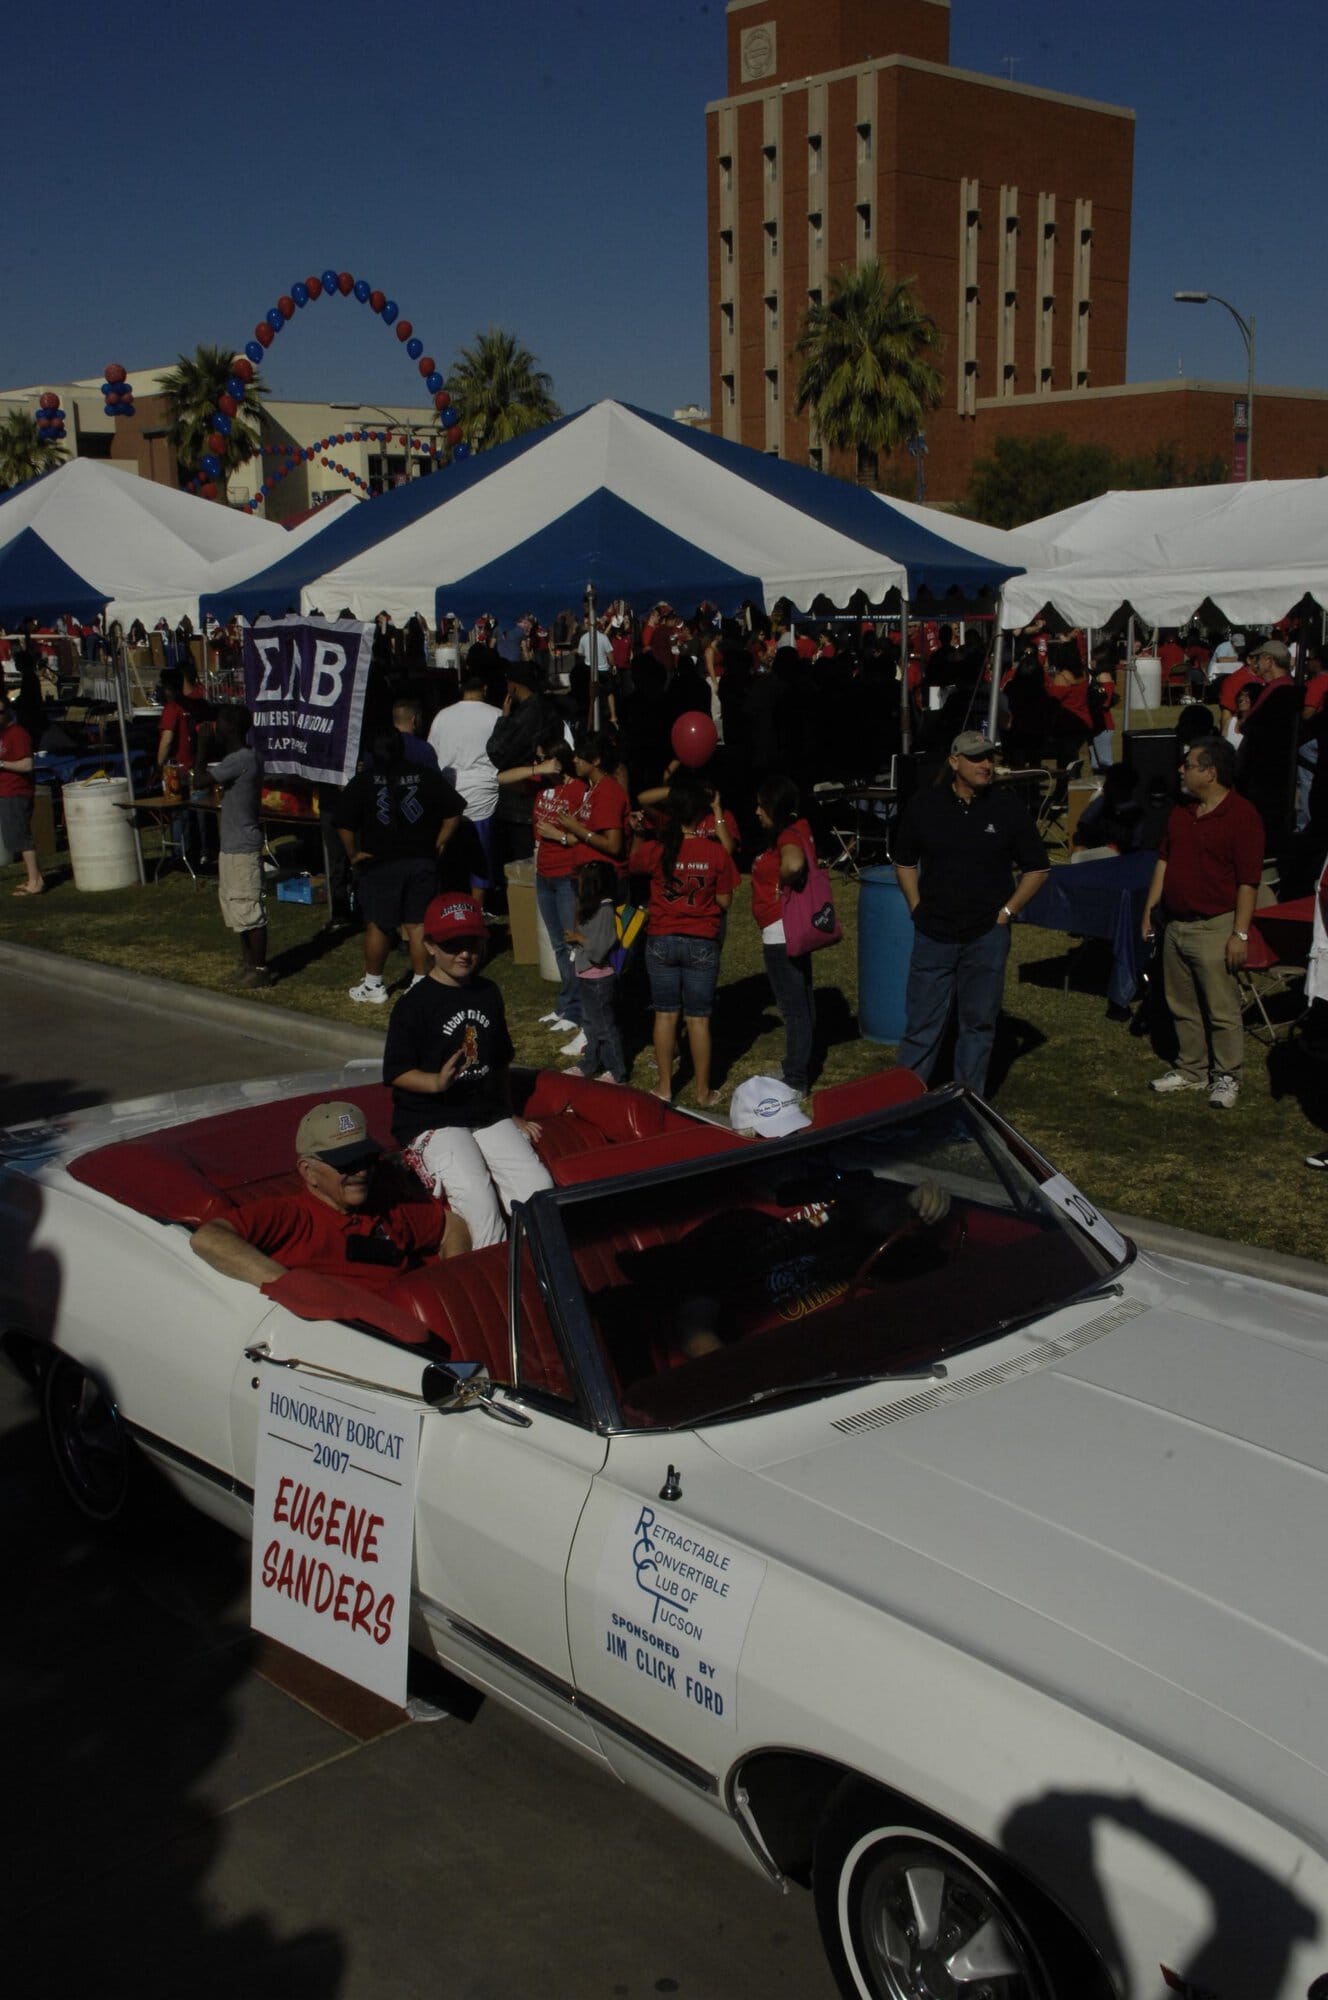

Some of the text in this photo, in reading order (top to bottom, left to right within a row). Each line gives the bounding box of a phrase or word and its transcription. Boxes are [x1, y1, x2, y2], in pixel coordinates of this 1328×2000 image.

[270, 1391, 404, 1460] HONORARY BOBCAT
[313, 1442, 350, 1474] 2007
[273, 1476, 385, 1563] EUGENE
[634, 1506, 731, 1571] RETRACTABLE
[262, 1539, 395, 1645] SANDERS
[632, 1538, 730, 1598] CONVERTIBLE
[636, 1558, 699, 1604] CLUB OF
[611, 1612, 716, 1679] SPONSORED BY
[650, 1589, 703, 1641] TUCSON
[606, 1631, 724, 1716] JIM CLICK FORD
